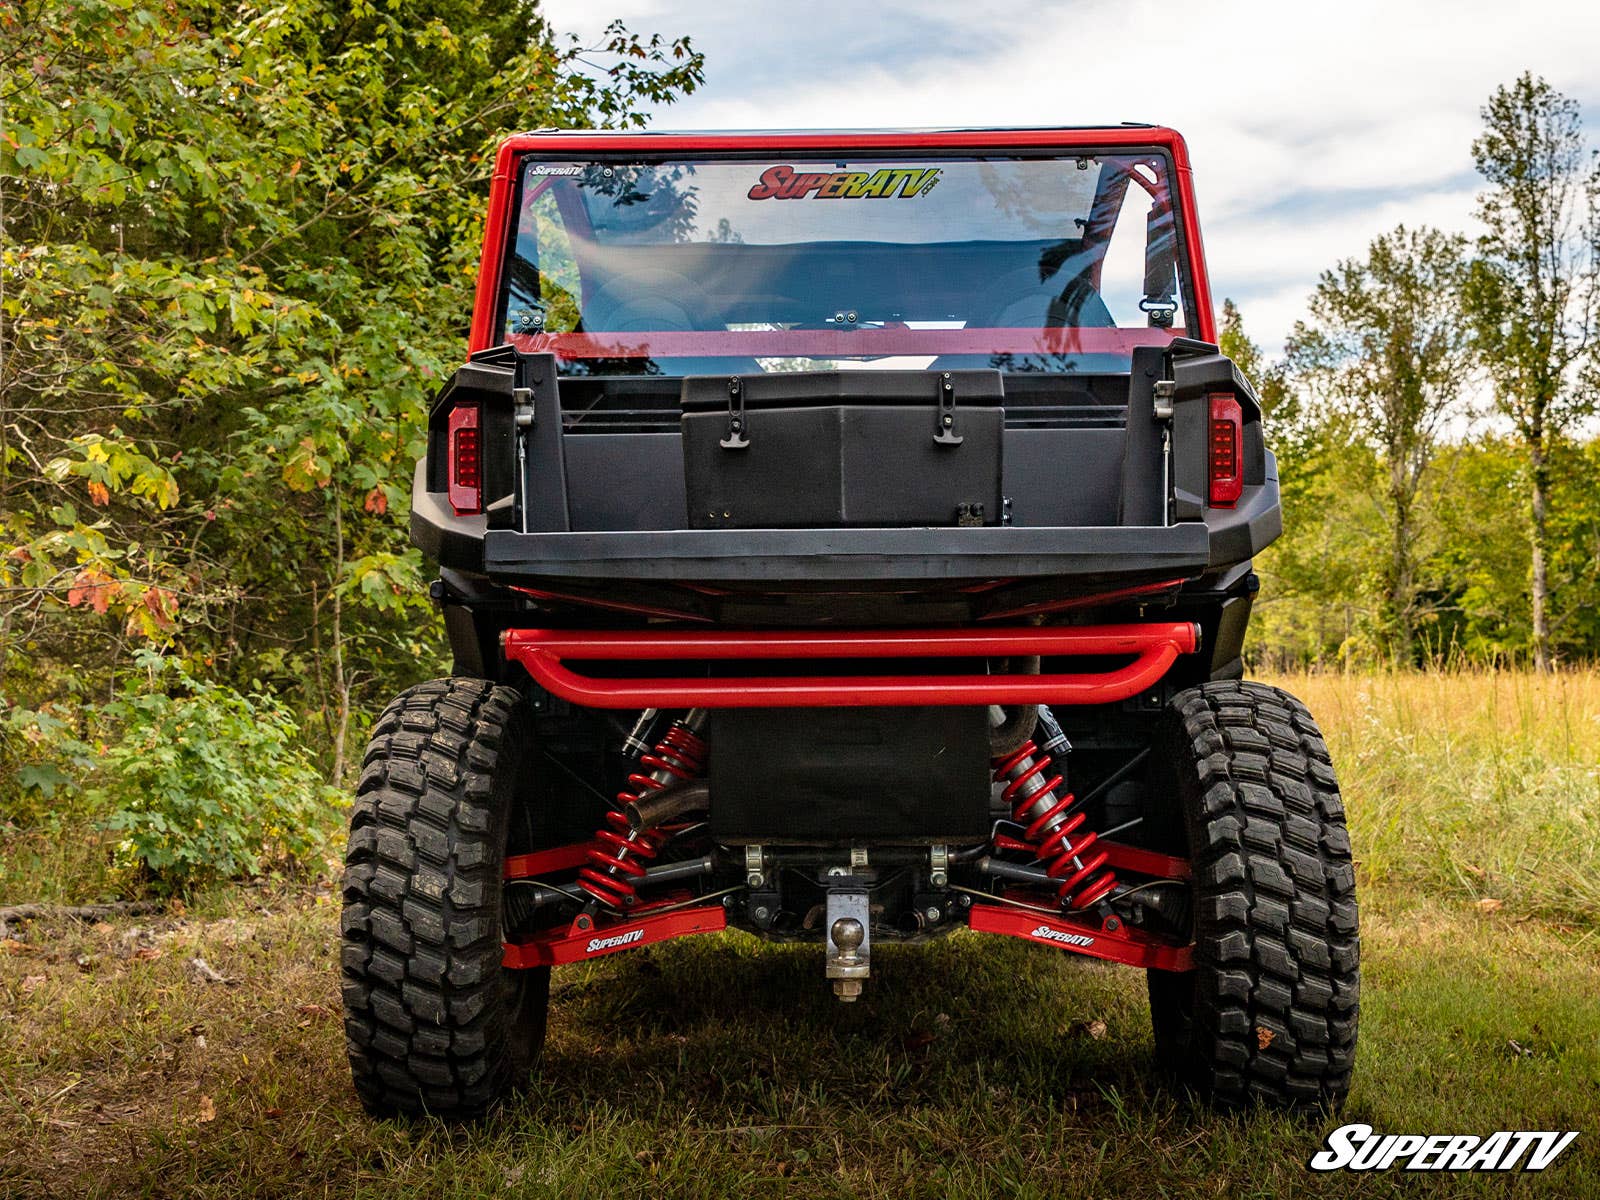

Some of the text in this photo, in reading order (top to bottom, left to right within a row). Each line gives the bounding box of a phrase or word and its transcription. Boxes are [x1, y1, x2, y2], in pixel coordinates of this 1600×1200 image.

[531, 165, 582, 175] SUPERATV
[748, 165, 941, 200] SUPERATV
[587, 929, 644, 952] SUPERATV
[1031, 925, 1094, 946] SUPERATV
